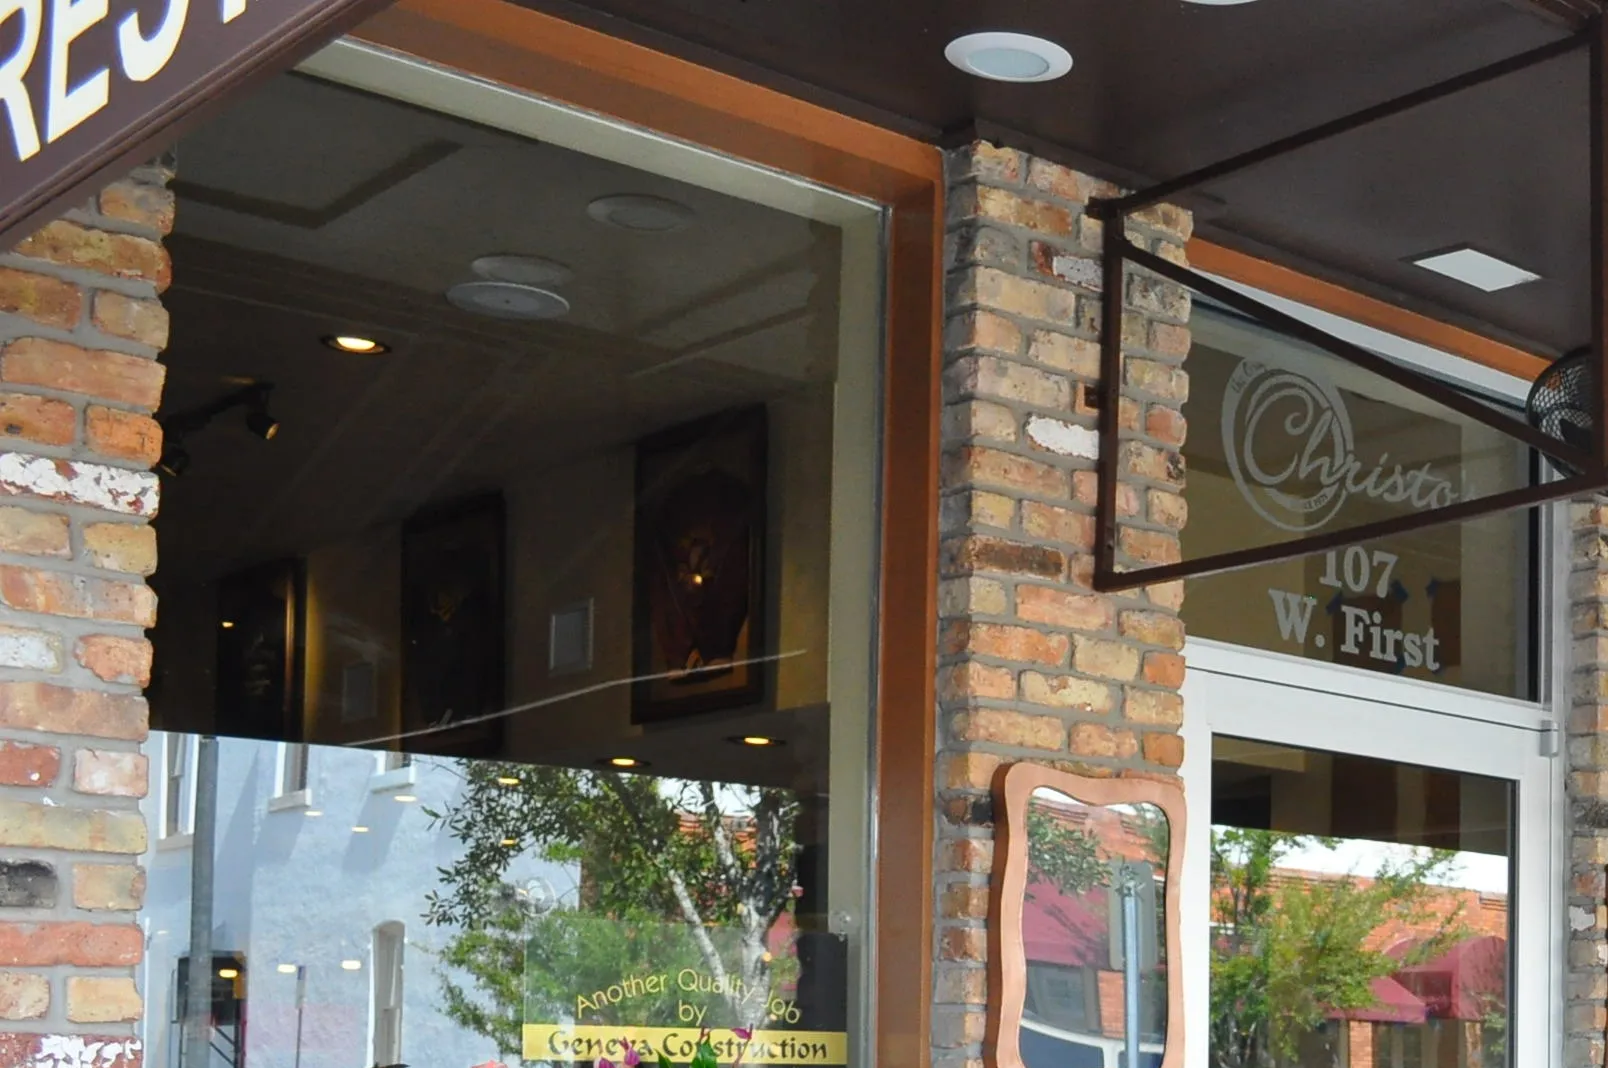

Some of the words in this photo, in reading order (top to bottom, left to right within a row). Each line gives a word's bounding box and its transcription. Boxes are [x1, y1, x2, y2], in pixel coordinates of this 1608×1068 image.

[0, 0, 247, 161] RE
[1318, 546, 1399, 599] 107
[1268, 587, 1325, 649] W.
[1341, 604, 1440, 672] First
[575, 972, 669, 1020] Another
[677, 967, 757, 1005] Quality
[678, 1000, 707, 1027] by
[662, 1032, 828, 1060] Costruction
